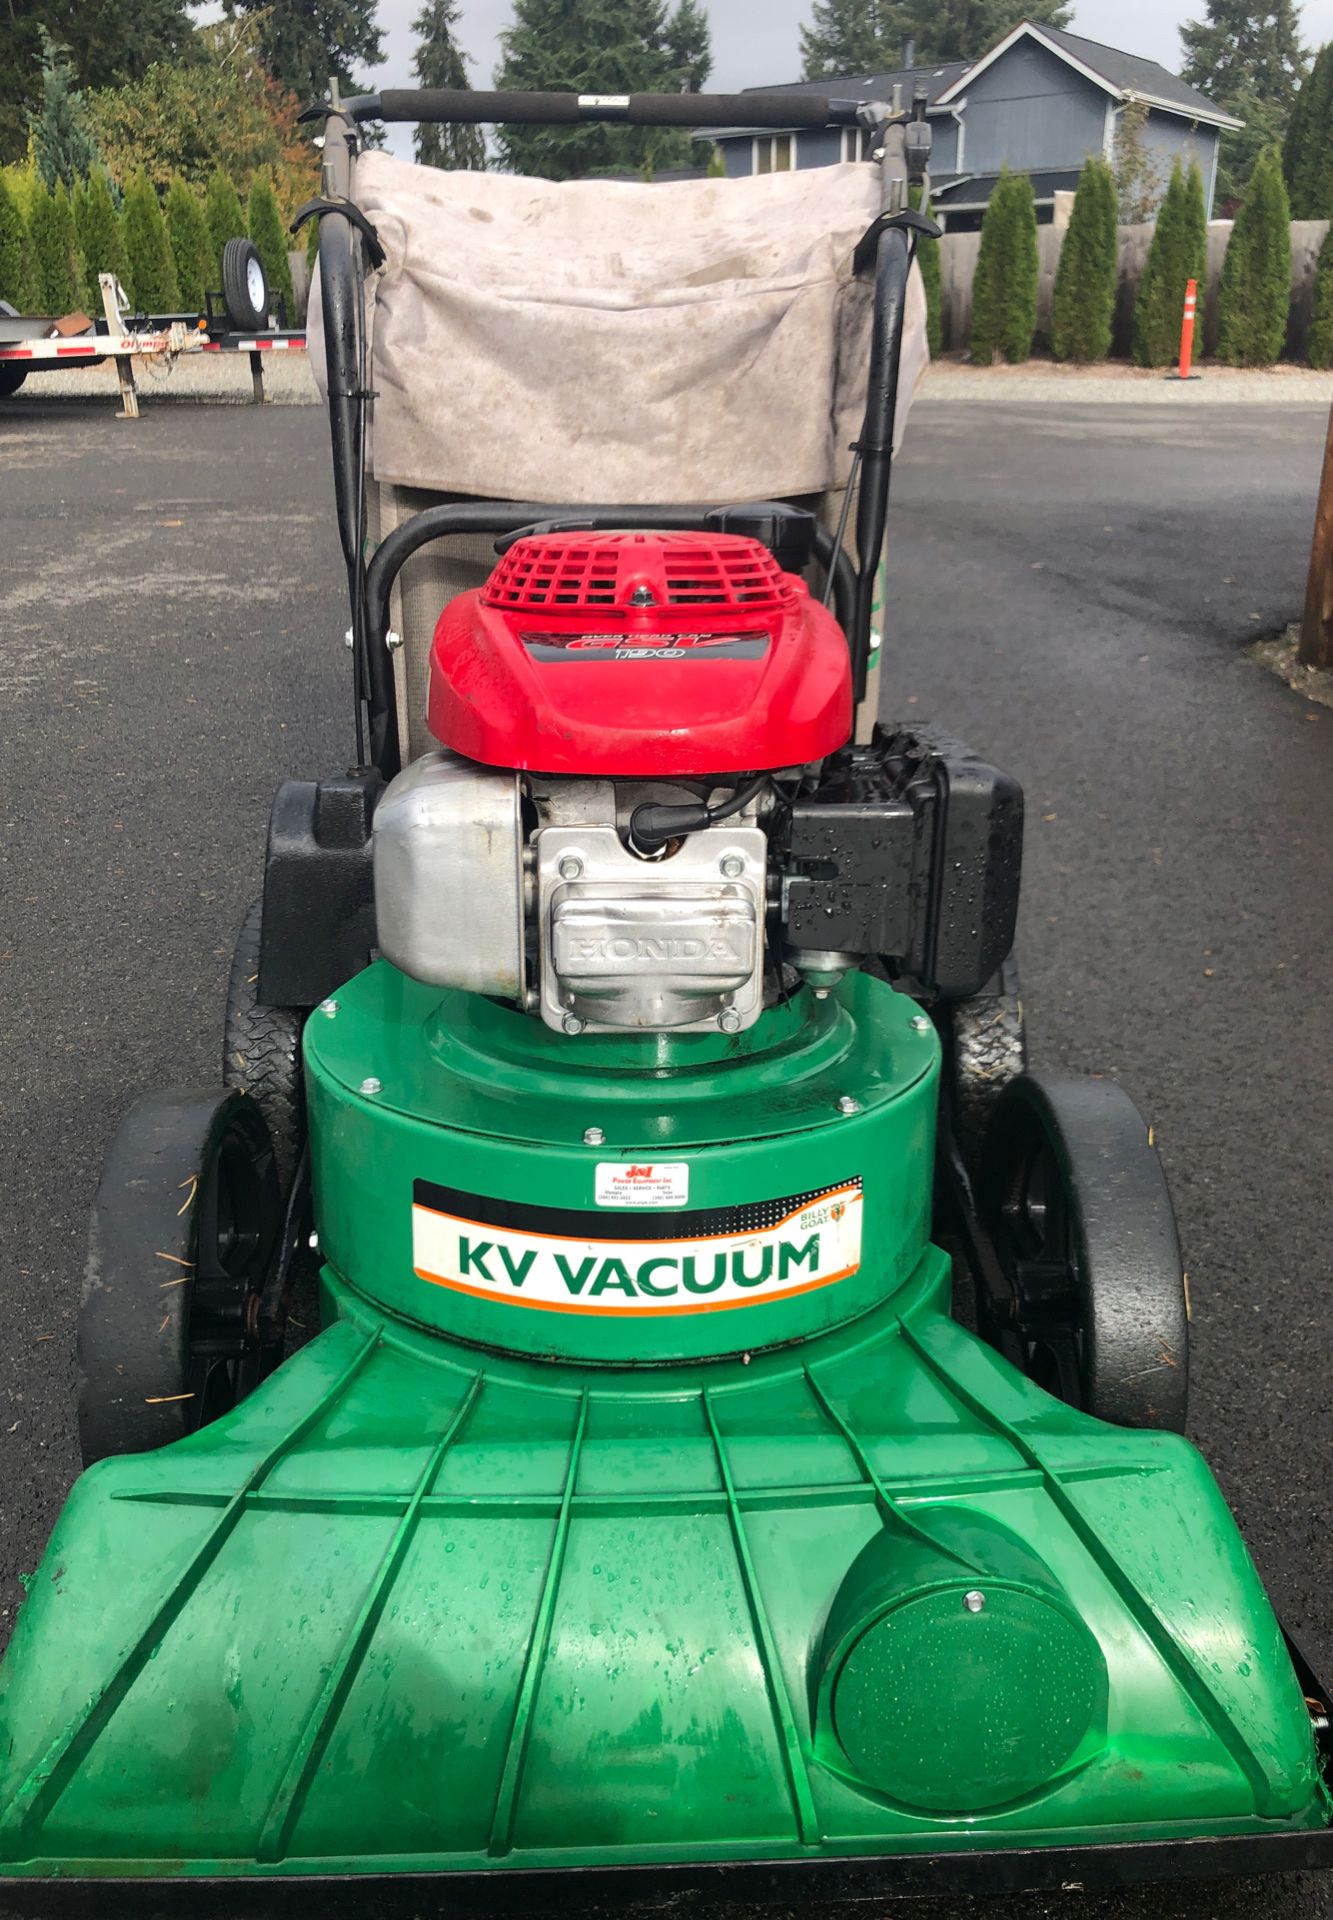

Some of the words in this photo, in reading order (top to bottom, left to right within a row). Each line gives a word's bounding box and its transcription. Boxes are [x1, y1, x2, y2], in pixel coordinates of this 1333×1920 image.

[568, 937, 741, 961] HONDA
[800, 1216, 829, 1230] GOAT
[801, 1206, 830, 1221] BILLY
[458, 1235, 539, 1287] KV
[552, 1232, 821, 1298] VACUUM
